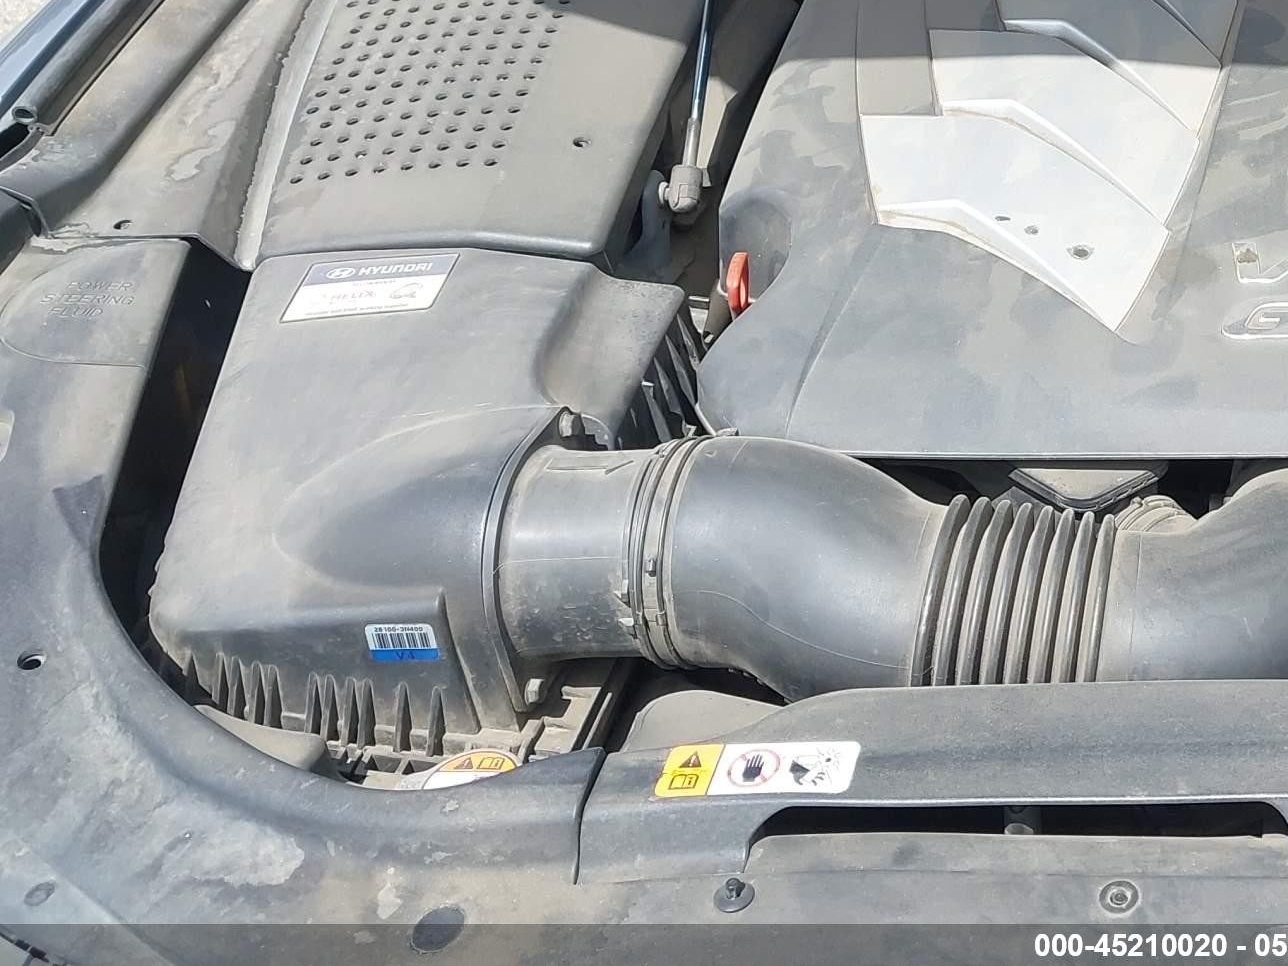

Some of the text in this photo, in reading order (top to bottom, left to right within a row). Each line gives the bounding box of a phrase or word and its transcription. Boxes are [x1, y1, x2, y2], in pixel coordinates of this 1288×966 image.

[358, 263, 433, 276] HYUNDAI
[66, 281, 133, 292] POWER
[40, 293, 136, 306] STEERING
[48, 306, 104, 318] FLUID
